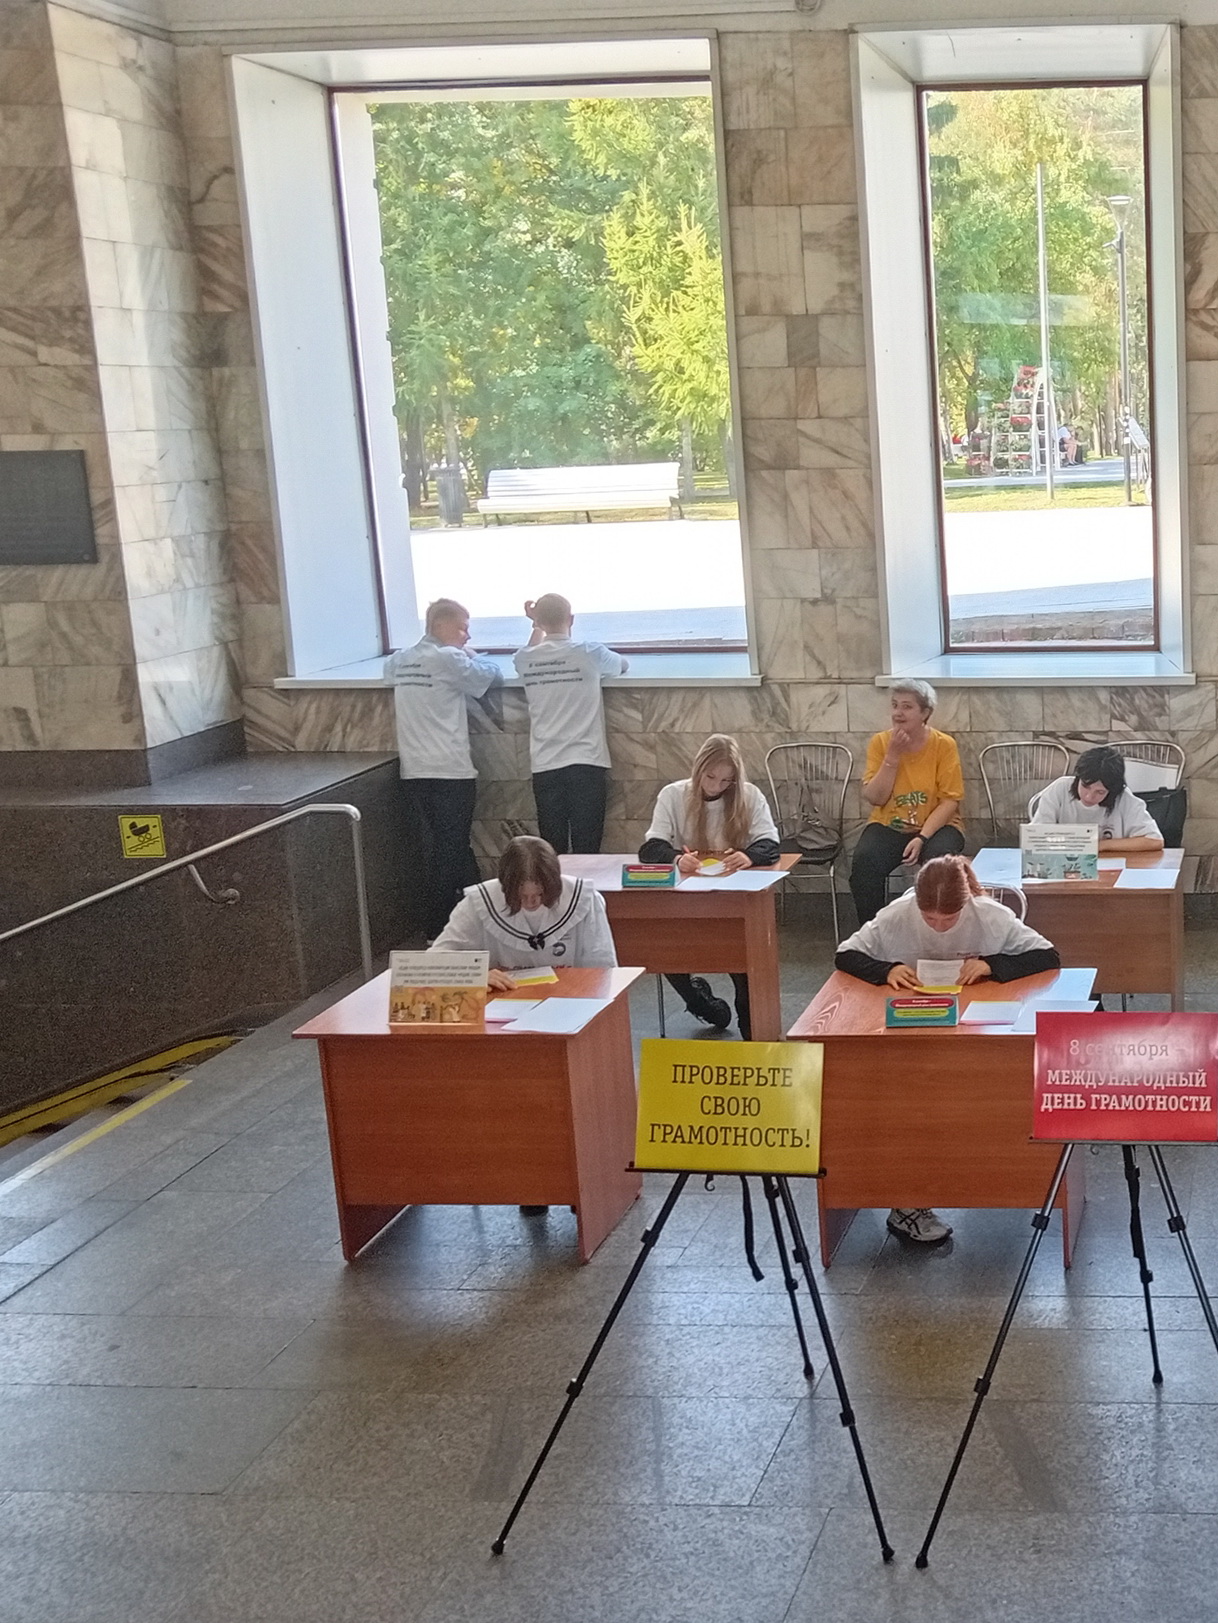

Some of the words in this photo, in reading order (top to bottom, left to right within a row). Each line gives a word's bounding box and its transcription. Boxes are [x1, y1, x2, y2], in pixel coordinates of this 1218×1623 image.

[1069, 1039, 1080, 1056] 8
[672, 1064, 793, 1087] ПРОВЕРЬТЕ
[1046, 1069, 1207, 1090] МЕЖДУНАРОДНЫЙ
[700, 1095, 761, 1117] СВОЮ
[1040, 1093, 1086, 1112] ДЕНЬ
[1090, 1094, 1212, 1112] ГРАМОТНОСТИ
[649, 1123, 811, 1148] ГРАМОТНОСТЬ!
